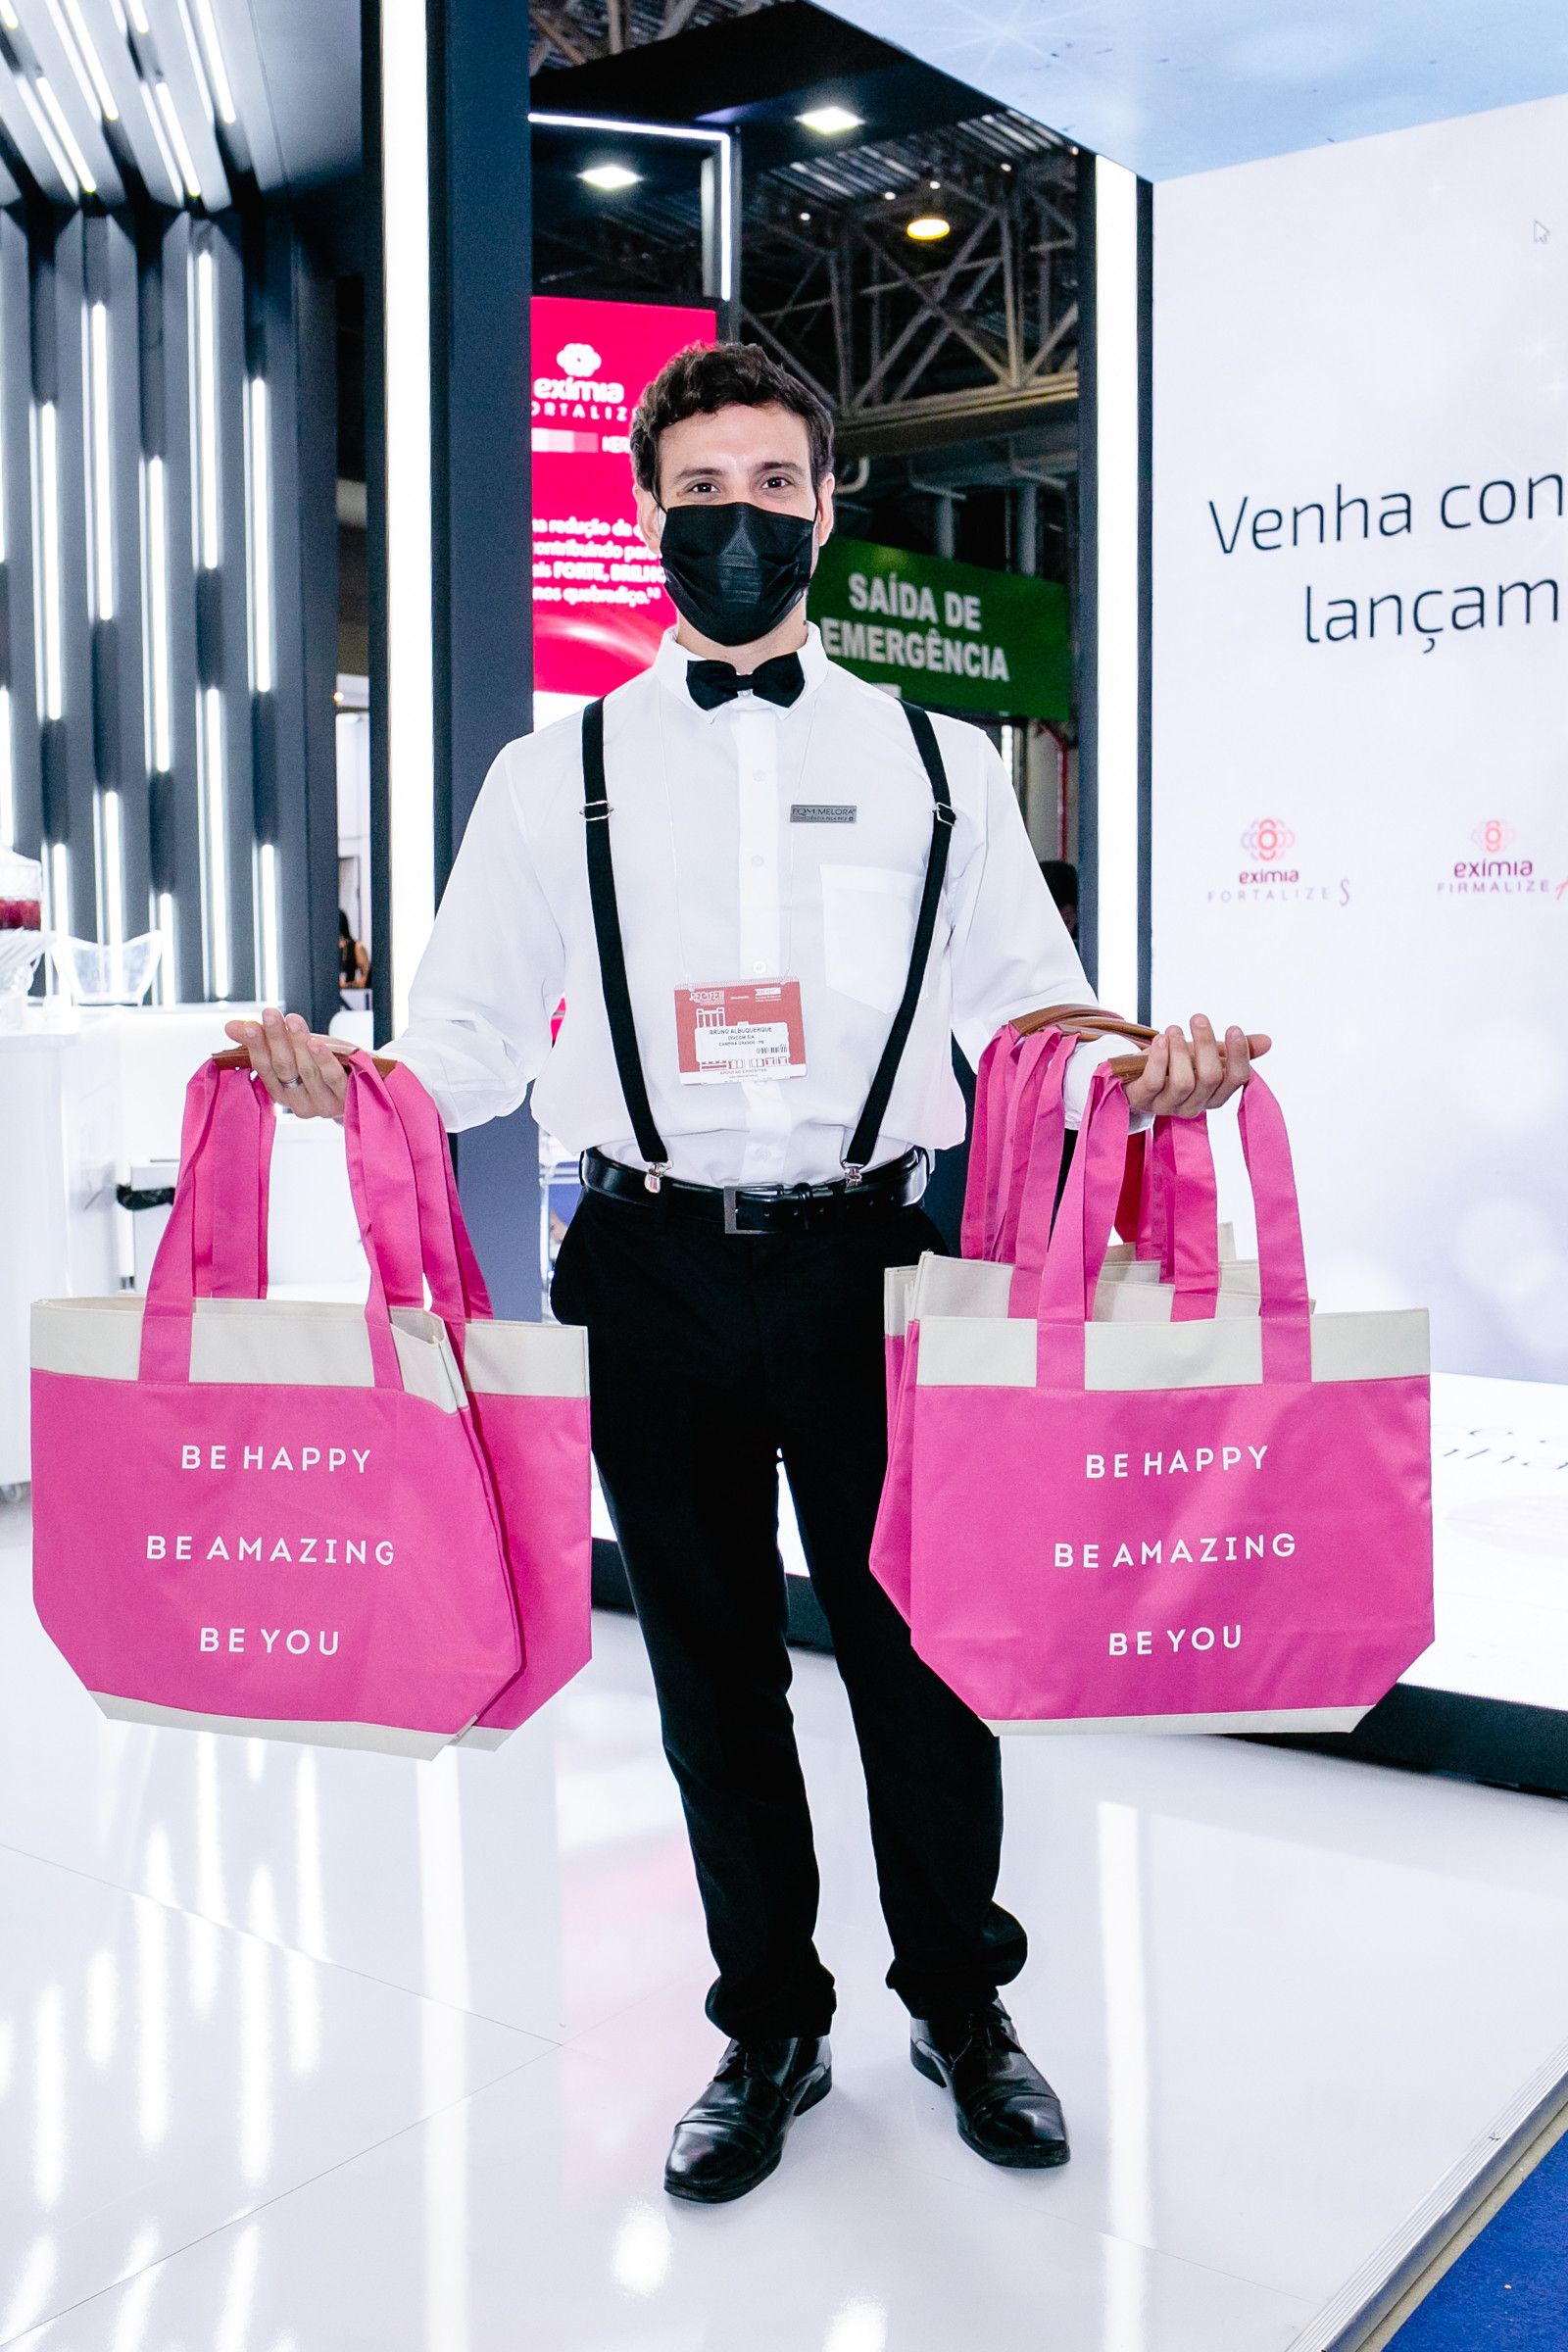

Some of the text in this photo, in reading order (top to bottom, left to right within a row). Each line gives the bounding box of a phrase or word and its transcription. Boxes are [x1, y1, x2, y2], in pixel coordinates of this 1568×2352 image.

[612, 517, 633, 537] da
[1208, 472, 1564, 555] Venha con
[532, 538, 623, 559] ontribuindo
[848, 571, 982, 632] SAÍDA DE
[1305, 578, 1559, 655] lançam
[820, 616, 1010, 683] EMERGÊNCIA
[182, 1445, 370, 1474] BE HAPPY
[1086, 1445, 1268, 1479] BE HAPPY
[147, 1535, 394, 1566] BE AMAZING
[1054, 1533, 1296, 1568] BE AMAZING
[200, 1627, 339, 1655] BE YOU
[1108, 1624, 1242, 1656] BE YOU
